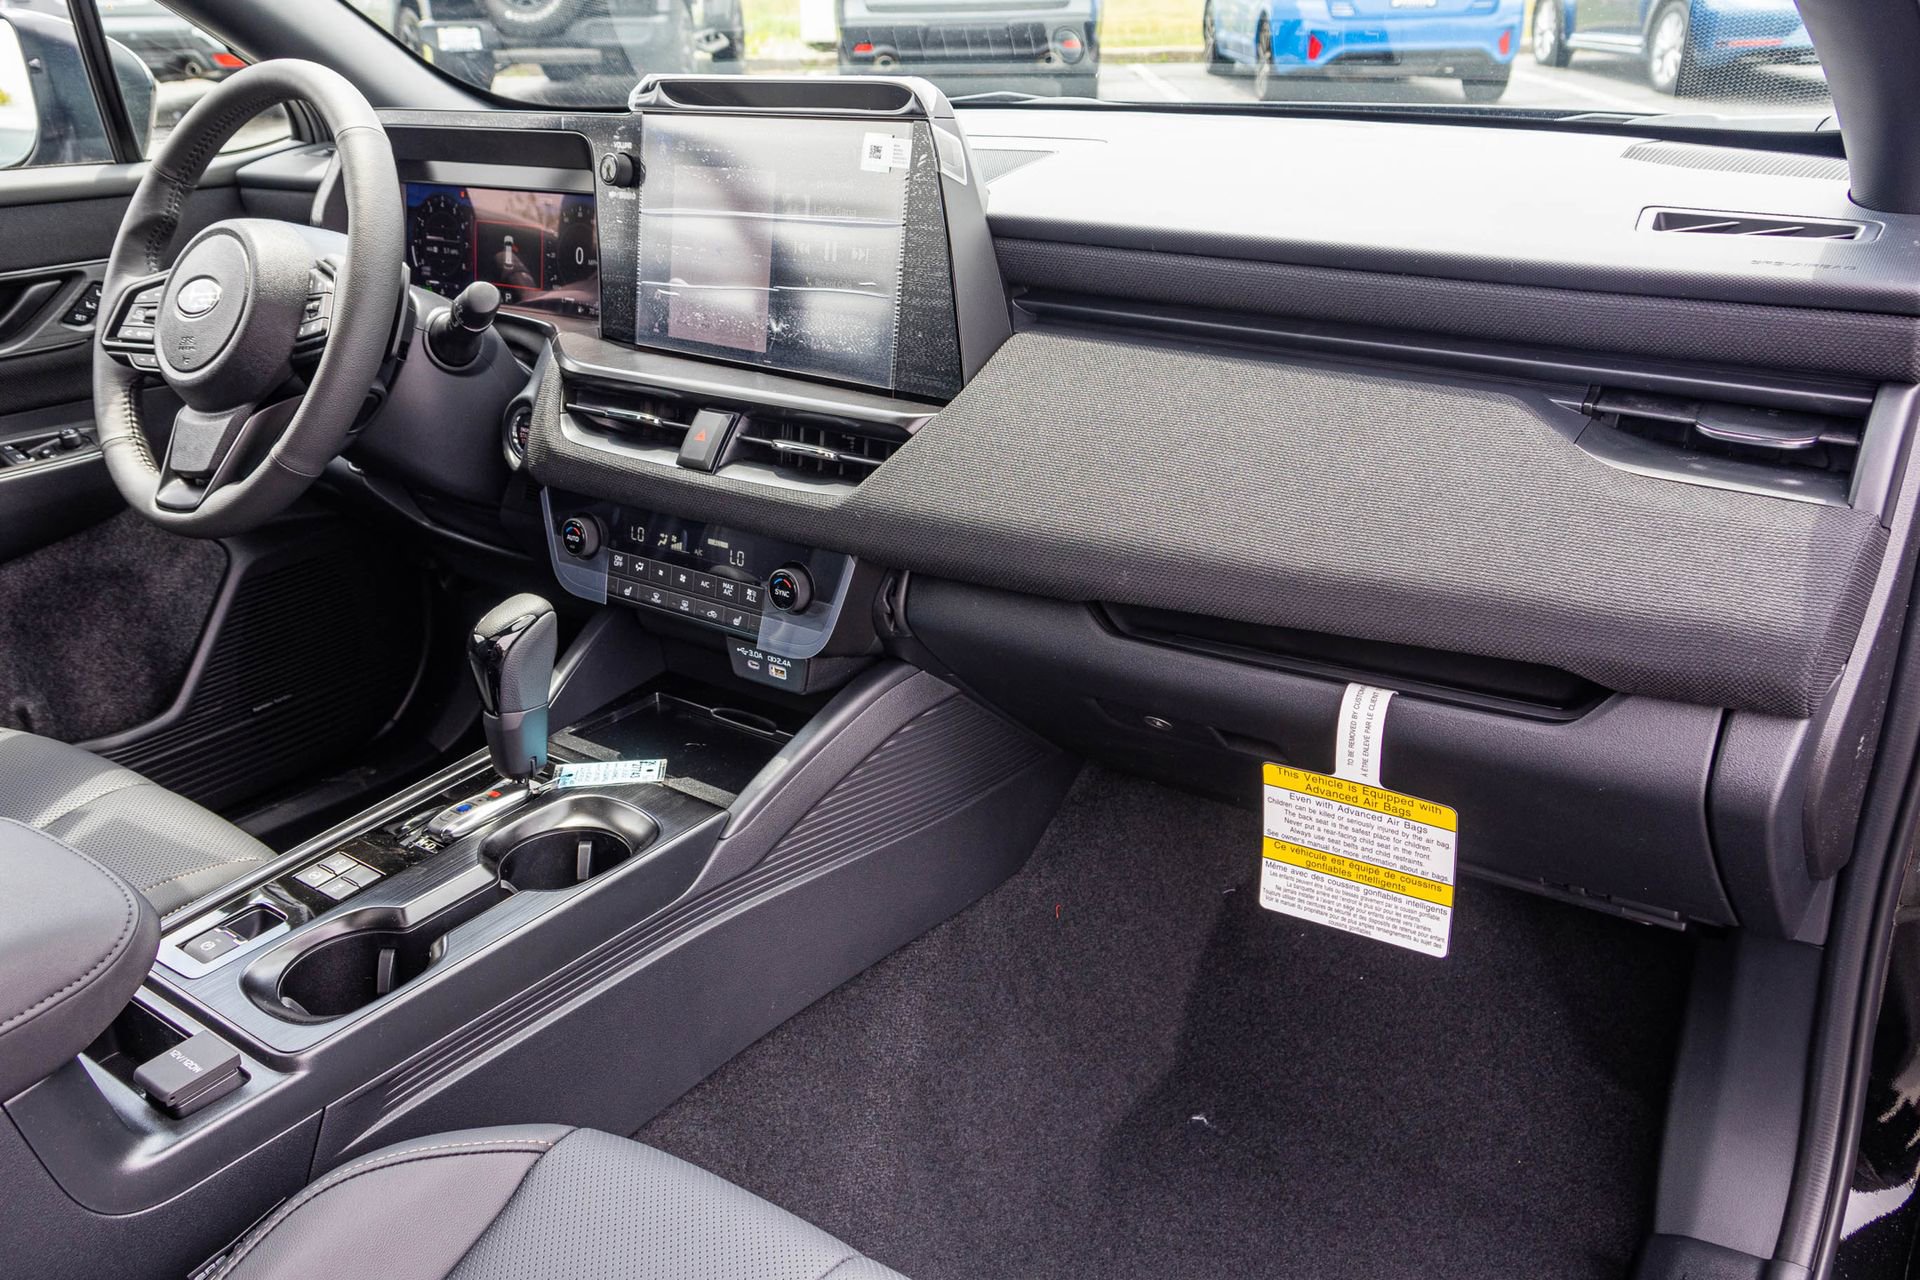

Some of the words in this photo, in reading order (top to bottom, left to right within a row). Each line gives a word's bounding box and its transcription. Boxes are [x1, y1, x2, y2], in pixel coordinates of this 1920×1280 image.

[576, 246, 584, 265] 0
[505, 293, 512, 302] P
[631, 526, 645, 542] LO
[729, 550, 744, 567] LO
[700, 580, 710, 589] A/C
[774, 588, 790, 598] SYNC
[1352, 711, 1358, 719] BY
[1369, 692, 1379, 710] CLIENT
[1349, 721, 1357, 748] REMOVED
[1348, 749, 1354, 758] BE
[1278, 767, 1299, 779] This
[1304, 773, 1343, 790] Vehicle
[1348, 784, 1357, 793] is
[1362, 787, 1414, 808] Equipped
[1419, 804, 1442, 814] with
[1305, 783, 1358, 803] Advanced
[1363, 797, 1377, 808] Air
[1383, 802, 1411, 817] Bags
[1267, 796, 1292, 808] Children
[1319, 809, 1335, 819] killed
[1347, 818, 1374, 830] seriously
[1377, 824, 1399, 835] injured
[1412, 833, 1423, 841] the
[1290, 792, 1311, 804] Even
[1315, 801, 1333, 810] with
[1338, 805, 1382, 822] Advanced
[1387, 817, 1399, 827] Air
[1404, 821, 1428, 834] Bags
[1284, 817, 1302, 827] Never
[1324, 829, 1357, 843] rear-facing
[1359, 837, 1374, 846] child
[1377, 842, 1390, 850] seat
[1402, 847, 1412, 855] the
[1285, 809, 1296, 817] The
[1299, 813, 1312, 821] back
[1315, 818, 1328, 826] seat
[1339, 823, 1348, 831] the
[1352, 828, 1370, 836] safest
[1373, 832, 1390, 841] place
[1404, 840, 1432, 852] children.
[1290, 827, 1311, 838] Always
[1344, 840, 1358, 850] belts
[1376, 850, 1390, 858] child
[1267, 828, 1278, 837] See
[1281, 834, 1305, 844] owner's
[1307, 840, 1329, 850] manual
[1343, 850, 1358, 858] more
[1362, 853, 1396, 868] information
[1400, 864, 1418, 873] about
[1432, 871, 1449, 881] bags.
[1274, 841, 1286, 851] Ce
[1290, 847, 1327, 862] véhicule
[1331, 858, 1345, 867] est
[1349, 861, 1380, 876] équipé
[1384, 870, 1395, 880] de
[1400, 876, 1442, 892] coussins
[1265, 860, 1287, 872] Même
[1291, 869, 1308, 878] avec
[1311, 872, 1324, 882] des
[1328, 879, 1360, 892] coussins
[1363, 888, 1402, 903] gonflables
[1406, 898, 1447, 915] intelligents
[1306, 861, 1351, 877] gonflables
[1356, 872, 1406, 892] intelligents
